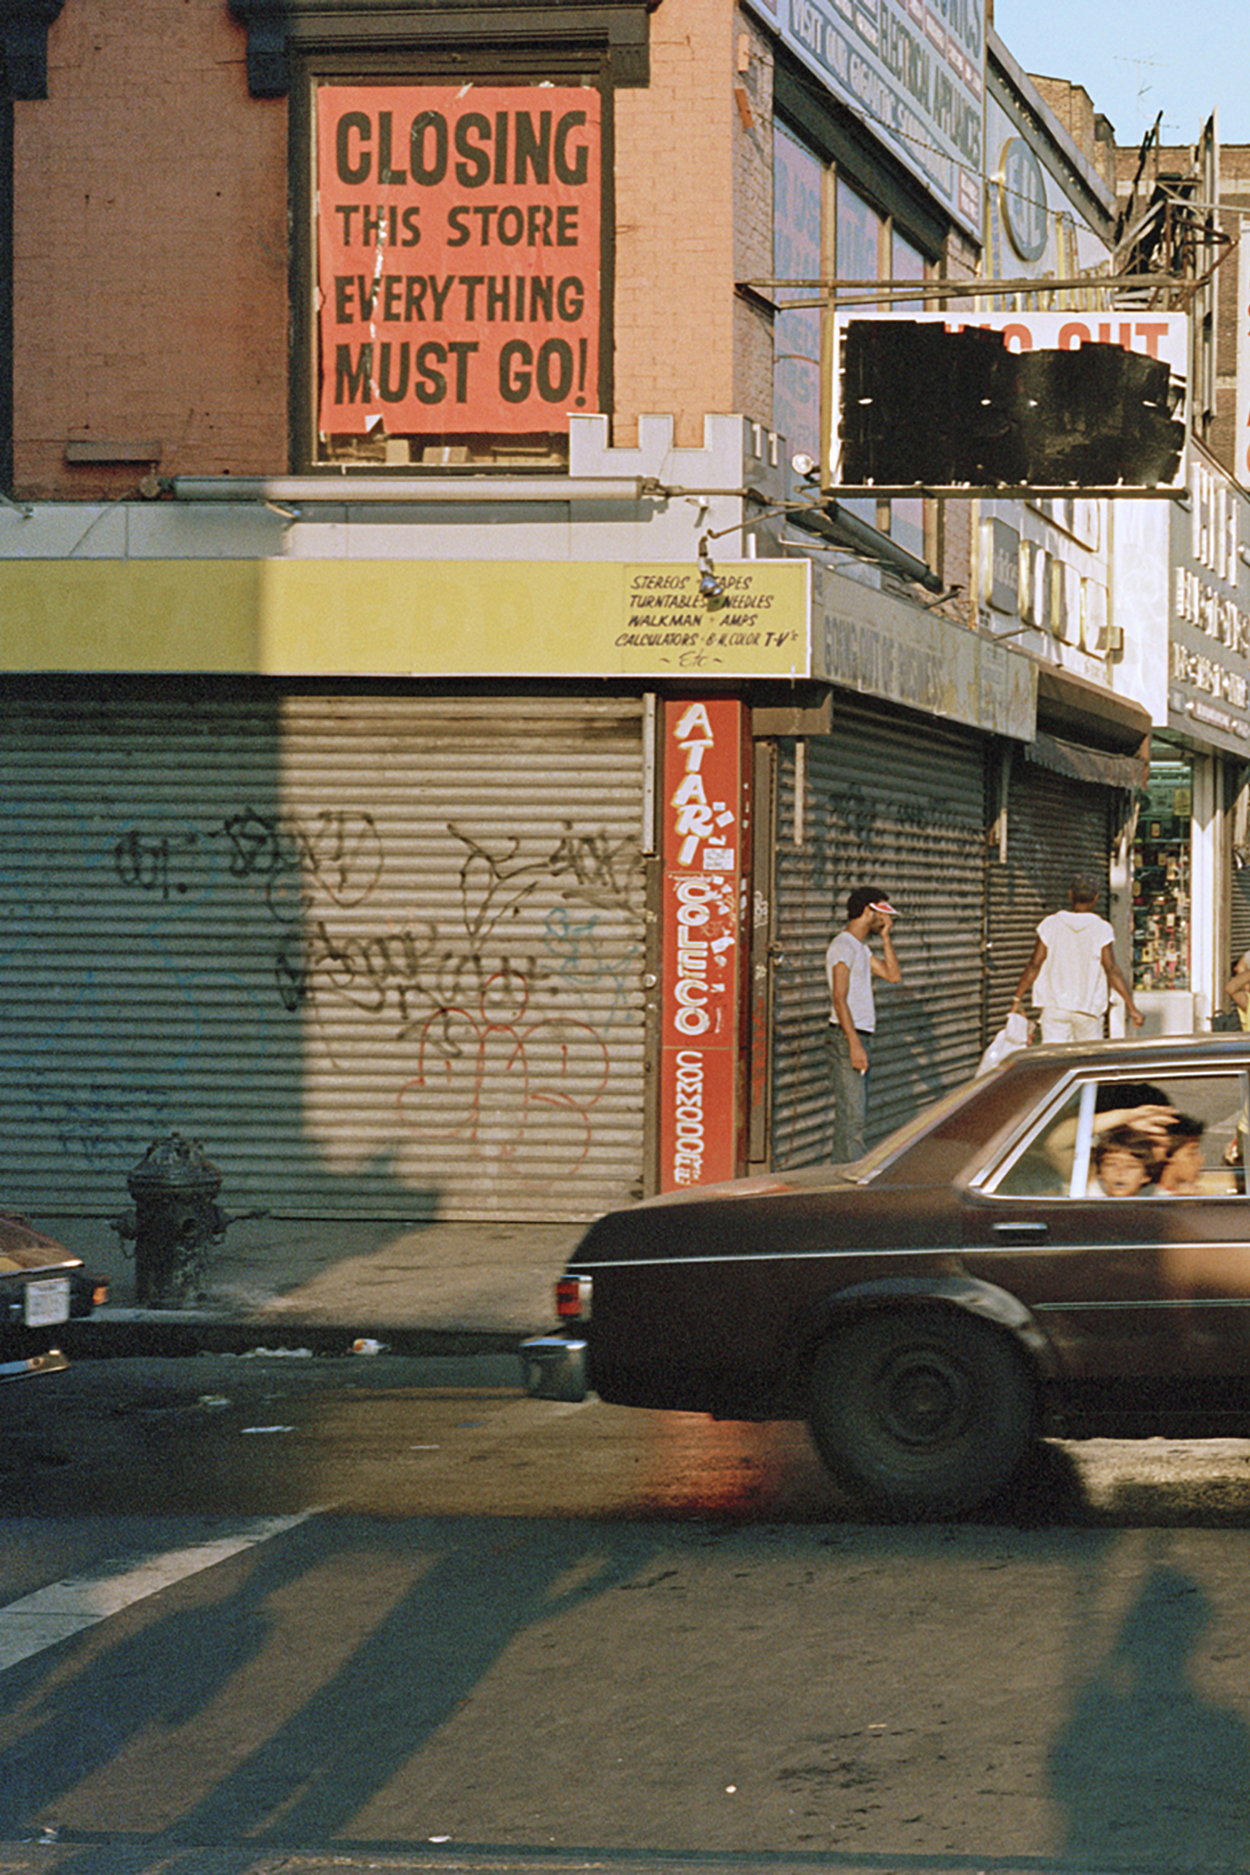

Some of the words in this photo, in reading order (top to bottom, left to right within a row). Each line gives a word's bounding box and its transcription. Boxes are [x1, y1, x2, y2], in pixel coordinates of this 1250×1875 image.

[334, 110, 590, 188] CLOSING
[334, 204, 421, 248] THIS
[447, 204, 579, 248] STORE
[335, 275, 585, 324] EVERYTHING
[334, 341, 480, 406] MUST
[498, 337, 588, 406] GO!
[629, 594, 708, 609] TURNTABLES
[722, 594, 774, 609] NEEDLES
[630, 575, 691, 590] STEREOS
[614, 633, 699, 647] CALCULATORS
[628, 614, 703, 627] WALKMAN
[719, 614, 758, 627] AMPS
[671, 703, 714, 866] ATARI
[673, 881, 711, 1036] COLECO
